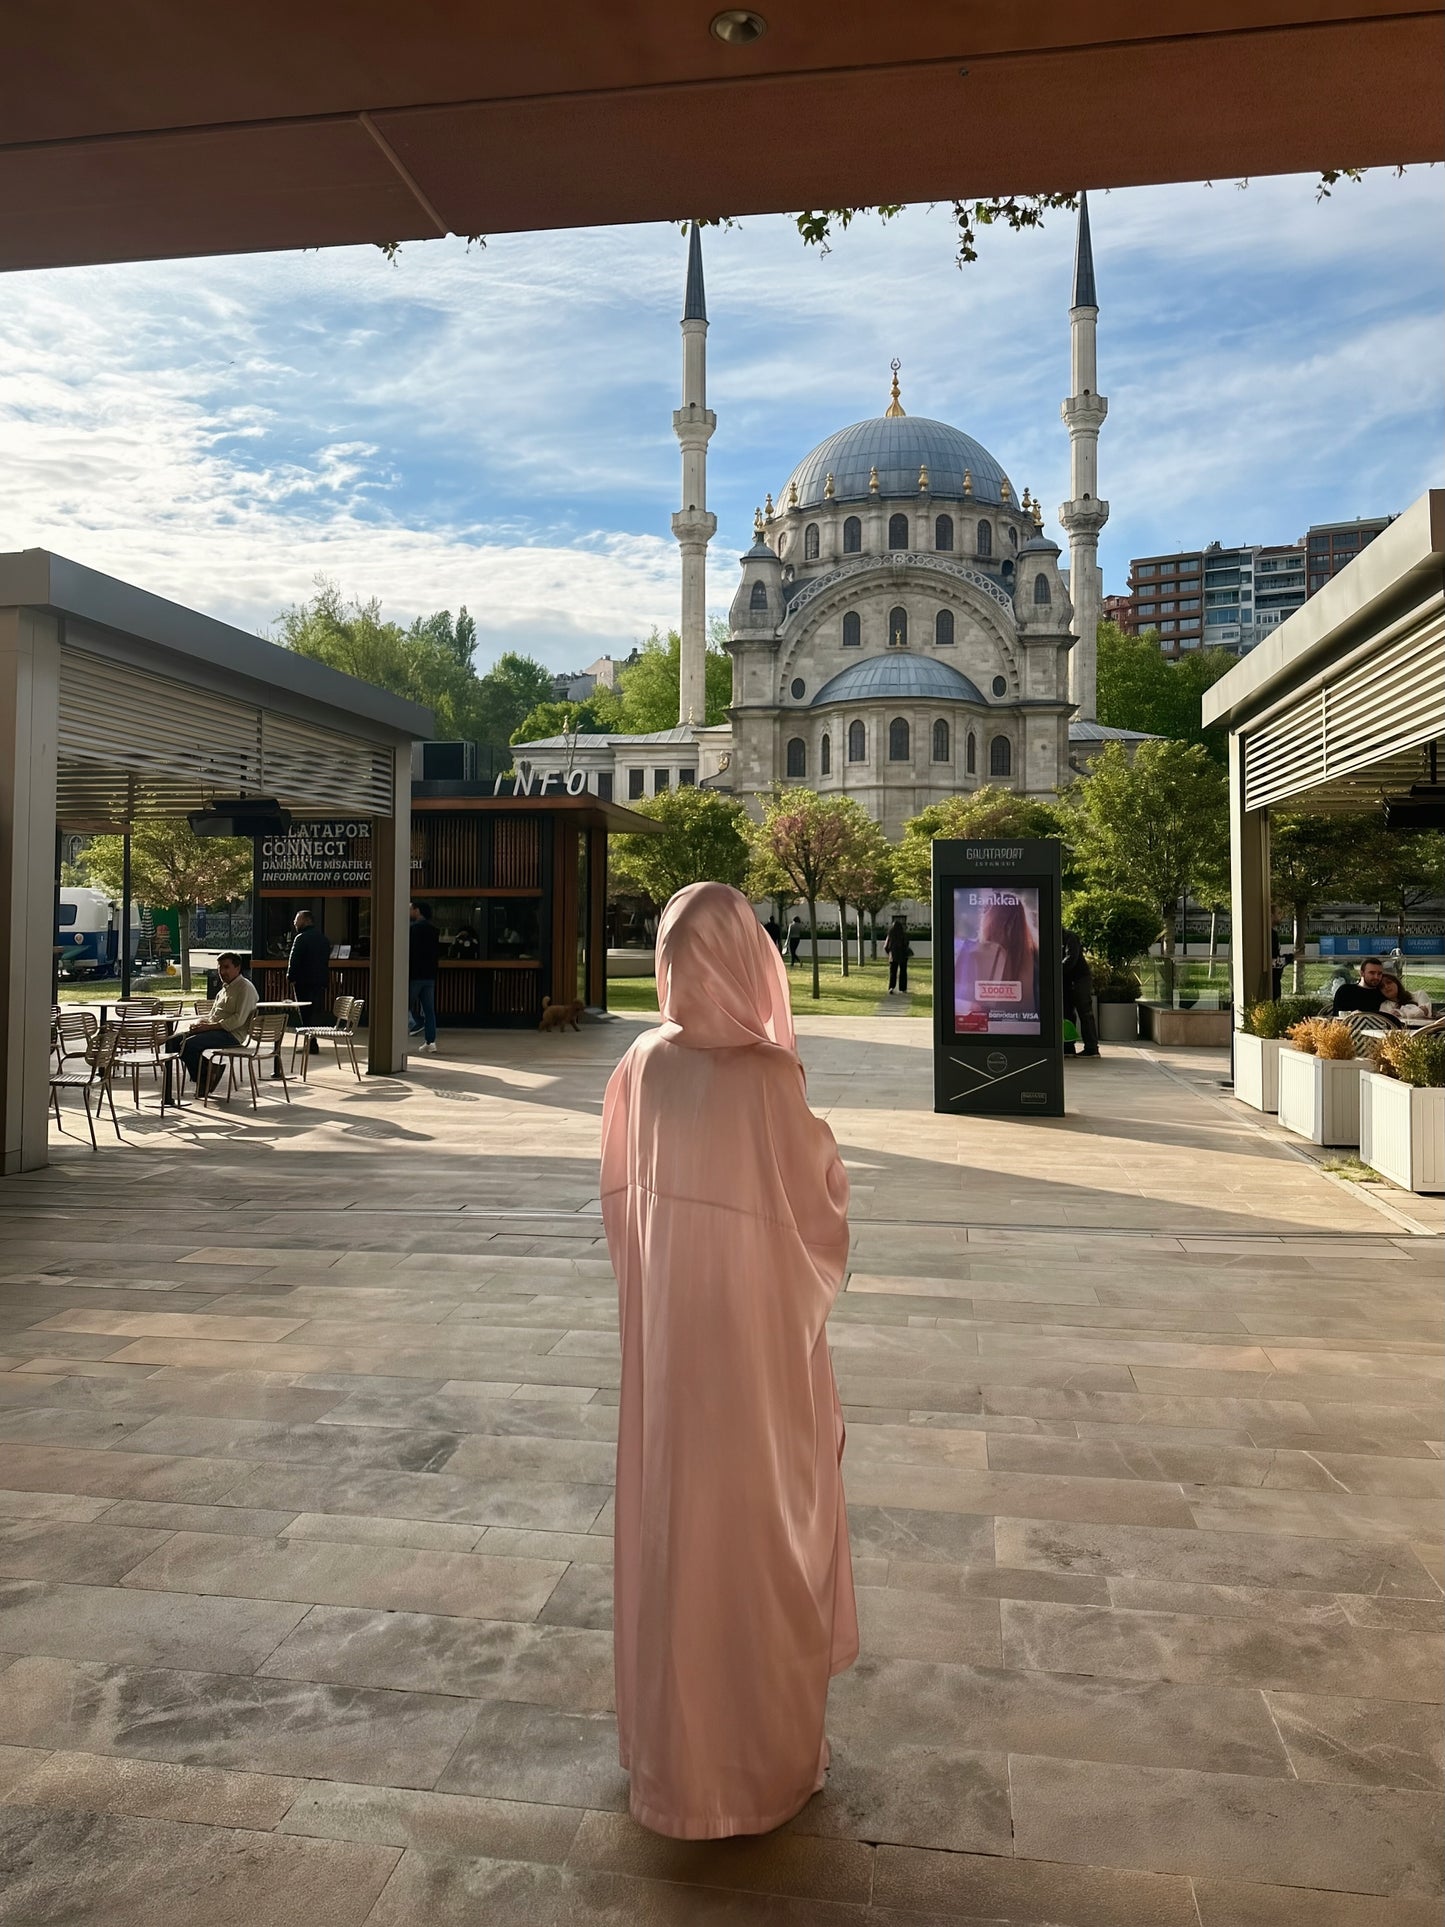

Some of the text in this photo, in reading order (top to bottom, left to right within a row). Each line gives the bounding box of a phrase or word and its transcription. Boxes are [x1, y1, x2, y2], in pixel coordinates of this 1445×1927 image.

[493, 769, 587, 797] INFO
[262, 841, 347, 856] CONNECT
[309, 860, 322, 870] VE
[262, 872, 332, 882] INFORMATION
[333, 872, 341, 881] &
